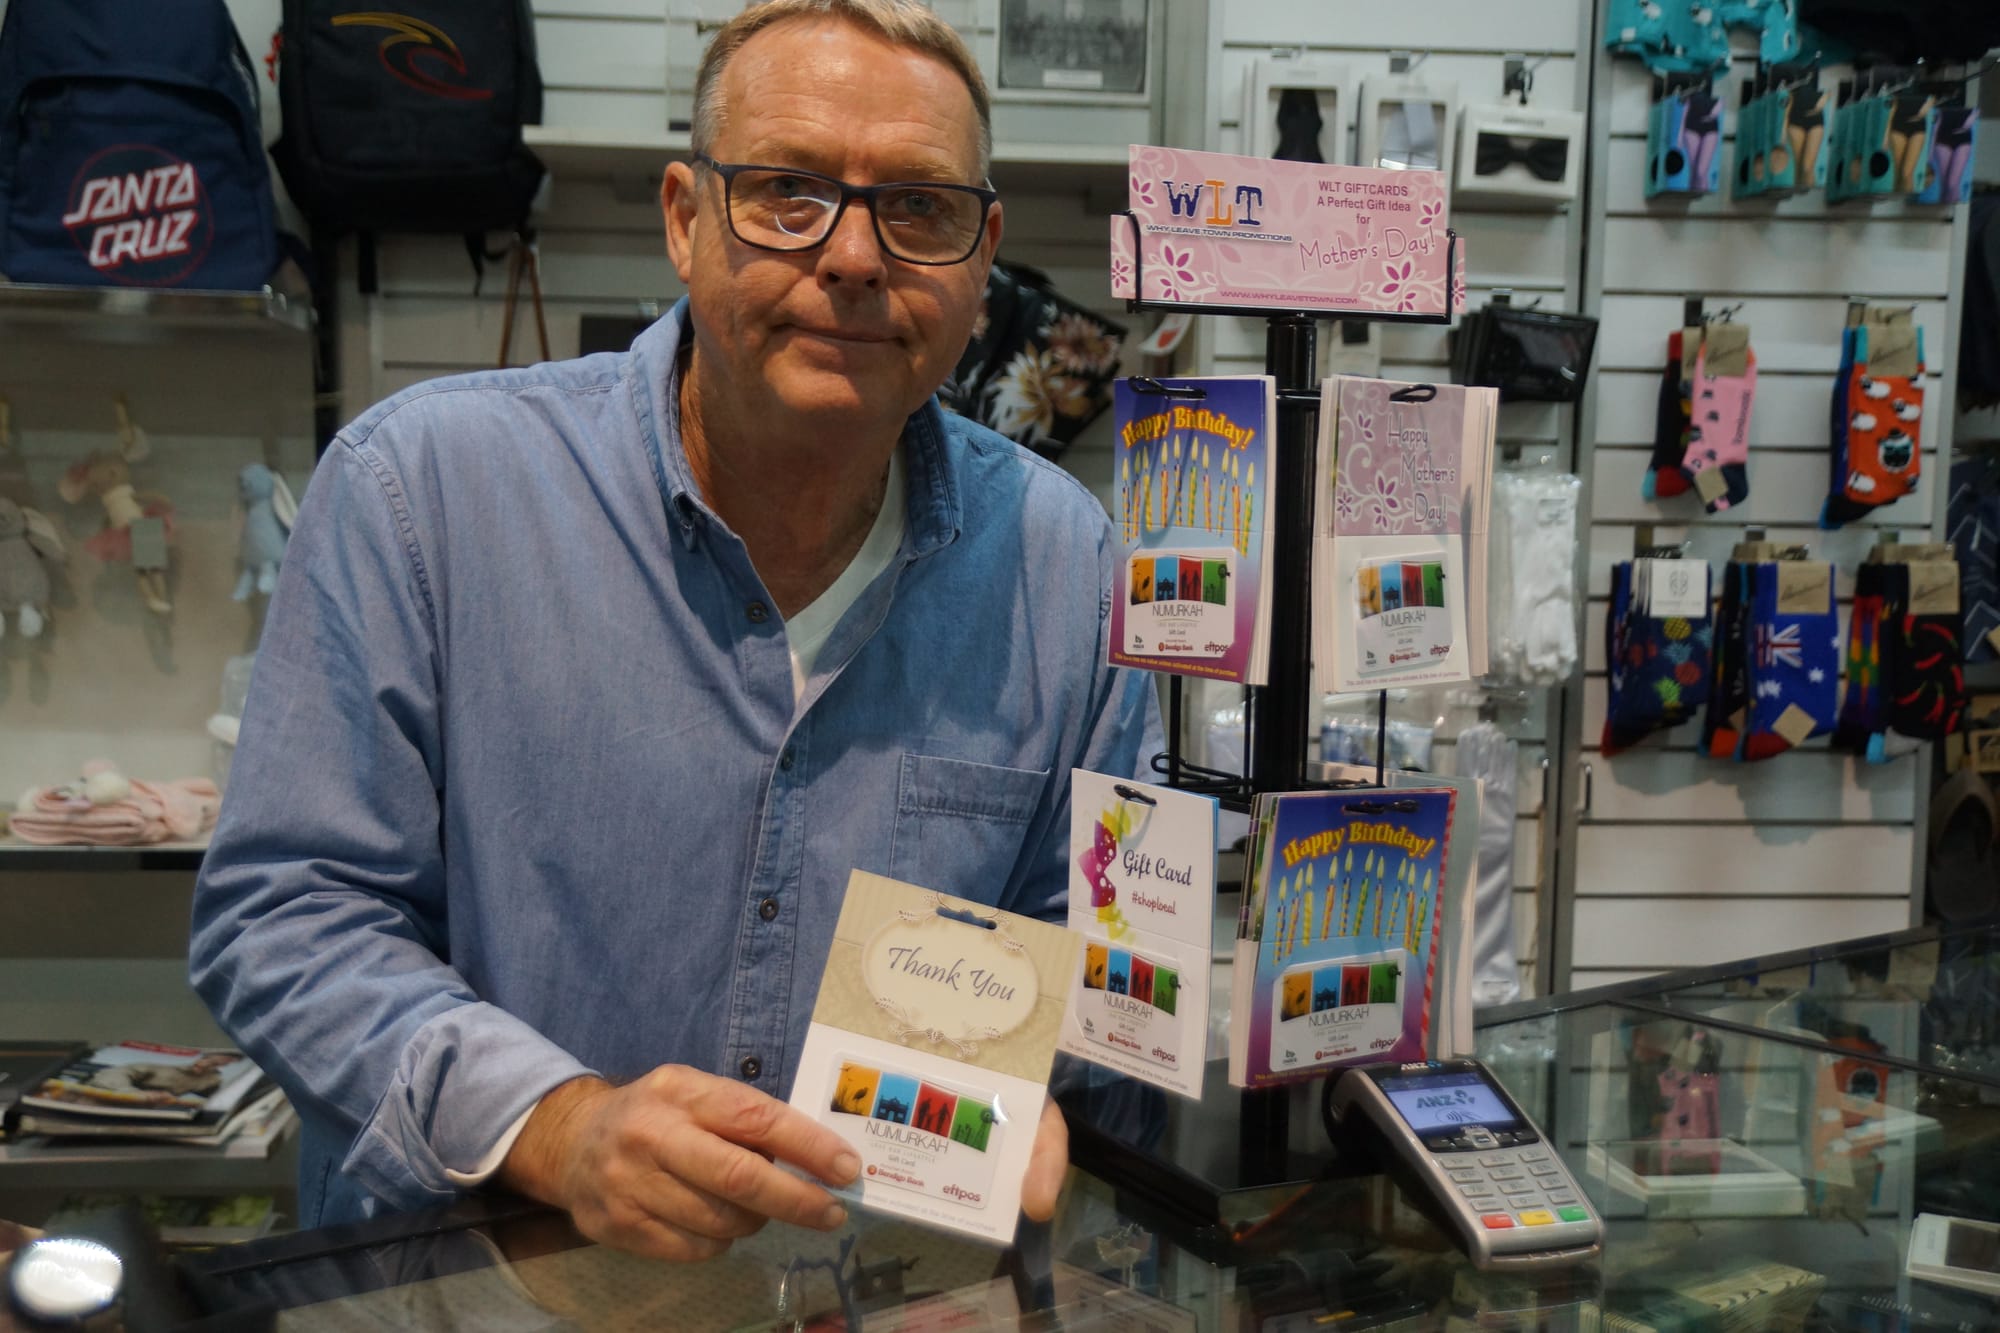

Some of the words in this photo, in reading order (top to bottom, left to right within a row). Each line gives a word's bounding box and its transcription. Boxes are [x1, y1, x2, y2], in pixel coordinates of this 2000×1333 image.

[62, 162, 198, 227] SANTA
[1162, 179, 1263, 226] WLT
[1318, 180, 1341, 193] WLT
[1343, 182, 1409, 198] GIFTCARDS
[1317, 196, 1325, 207] A
[1327, 197, 1365, 210] Perfect
[1366, 199, 1387, 211] Gift
[1388, 201, 1411, 212] Idea
[1356, 213, 1371, 225] for
[88, 208, 198, 270] CRUZ
[1171, 226, 1201, 235] LEAVE
[1202, 229, 1231, 237] TOWN
[1232, 231, 1293, 242] PROMOTIONS
[1299, 231, 1379, 272] Mother's
[1384, 224, 1436, 258] Day!
[1121, 411, 1171, 449] Happy
[1173, 405, 1256, 450] Birthday!
[1388, 412, 1429, 448] Happy
[1400, 452, 1456, 484] Mother's
[1414, 491, 1448, 525] Day!
[1152, 603, 1204, 617] NUMURKAH
[1281, 826, 1346, 868] Happy
[1347, 821, 1437, 860] Birthday!
[1122, 849, 1150, 879] Gift
[1155, 857, 1193, 886] Card
[1131, 889, 1177, 915] #shoplocal
[888, 946, 966, 991] Thank
[969, 968, 1016, 1001] You
[1103, 992, 1154, 1021] NUMURKAH
[1308, 1006, 1370, 1028] NUMURKAH
[1151, 1046, 1177, 1063] eftpos
[1416, 1094, 1456, 1109] ANZ
[864, 1119, 951, 1155] NUMURKAH
[888, 1153, 901, 1164] Gift
[900, 1156, 917, 1168] Card
[878, 1167, 906, 1183] Bendigo
[906, 1175, 925, 1188] Bank
[942, 1183, 982, 1203] eftpos
